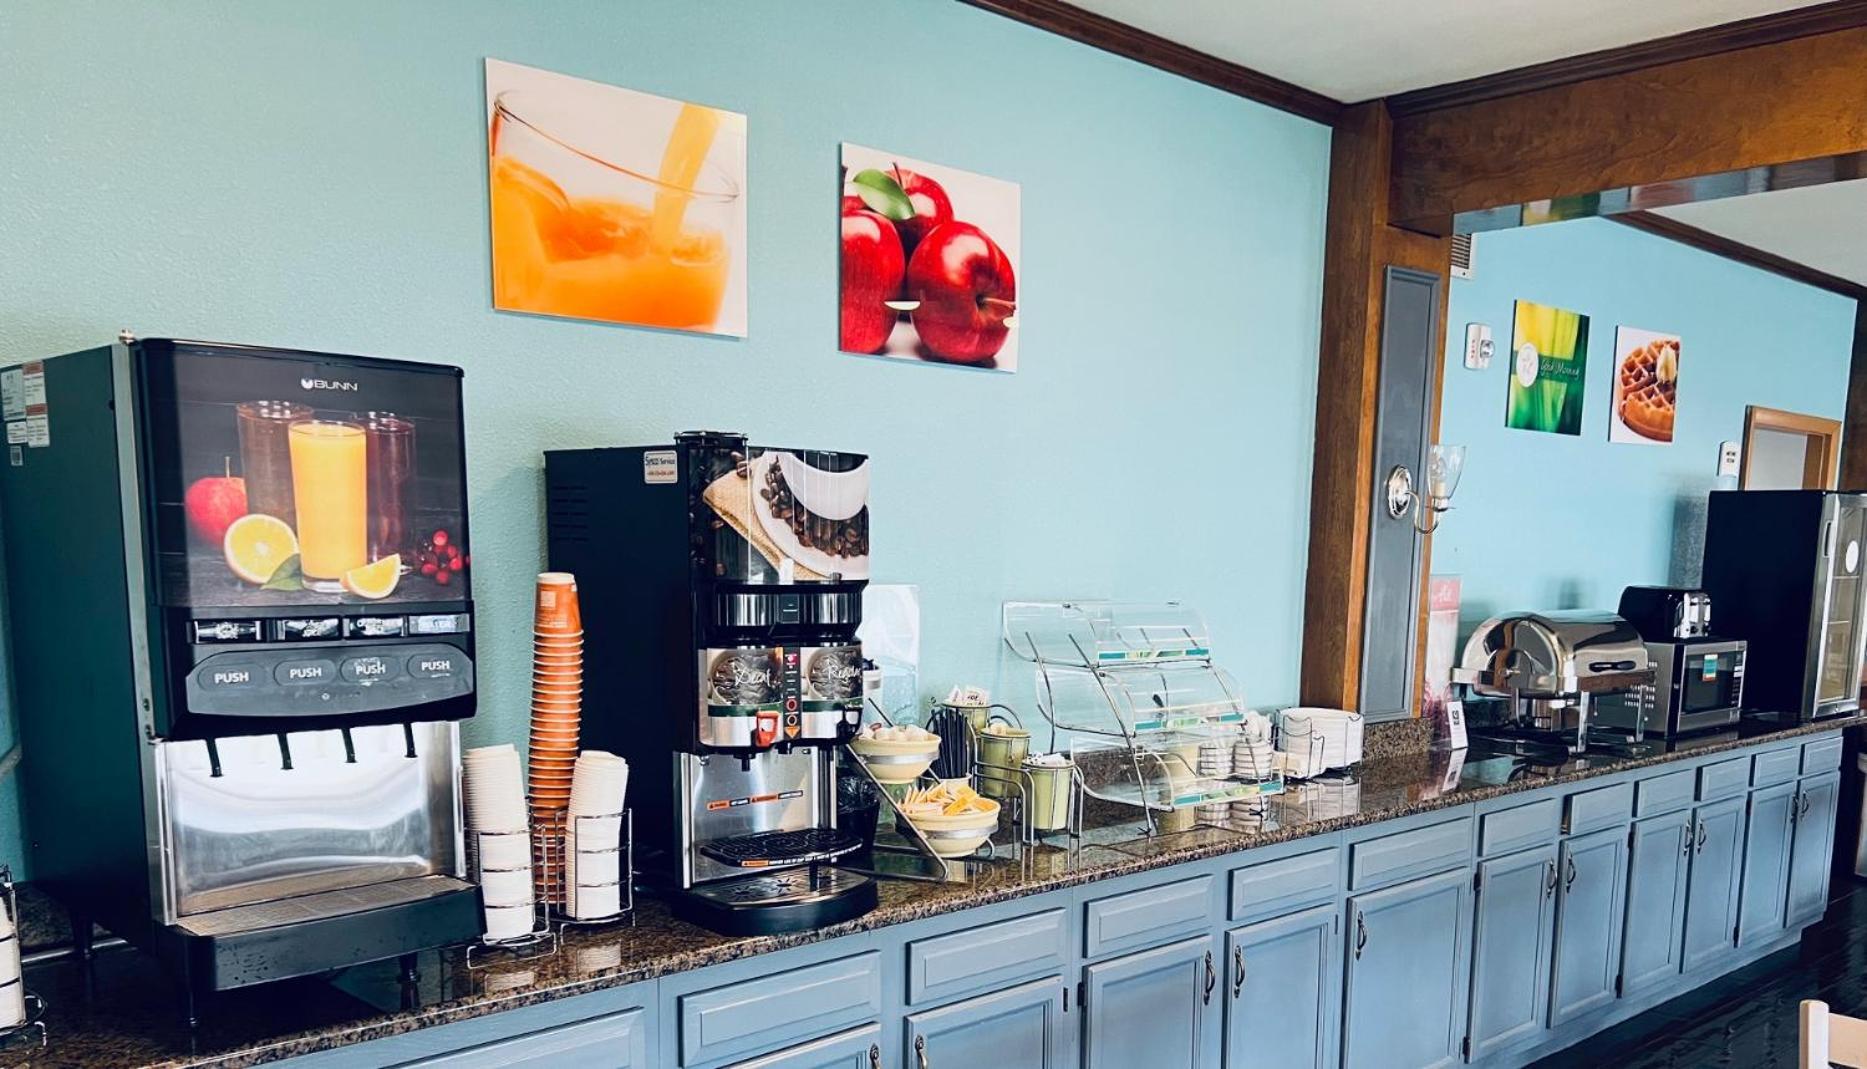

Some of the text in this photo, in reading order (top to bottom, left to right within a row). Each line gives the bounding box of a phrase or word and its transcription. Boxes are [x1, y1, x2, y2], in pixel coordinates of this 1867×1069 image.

[314, 379, 358, 391] BUNN
[355, 664, 386, 676] PUSH
[421, 660, 450, 672] PUSH
[214, 671, 249, 684] PUSH
[289, 667, 322, 679] PUSH
